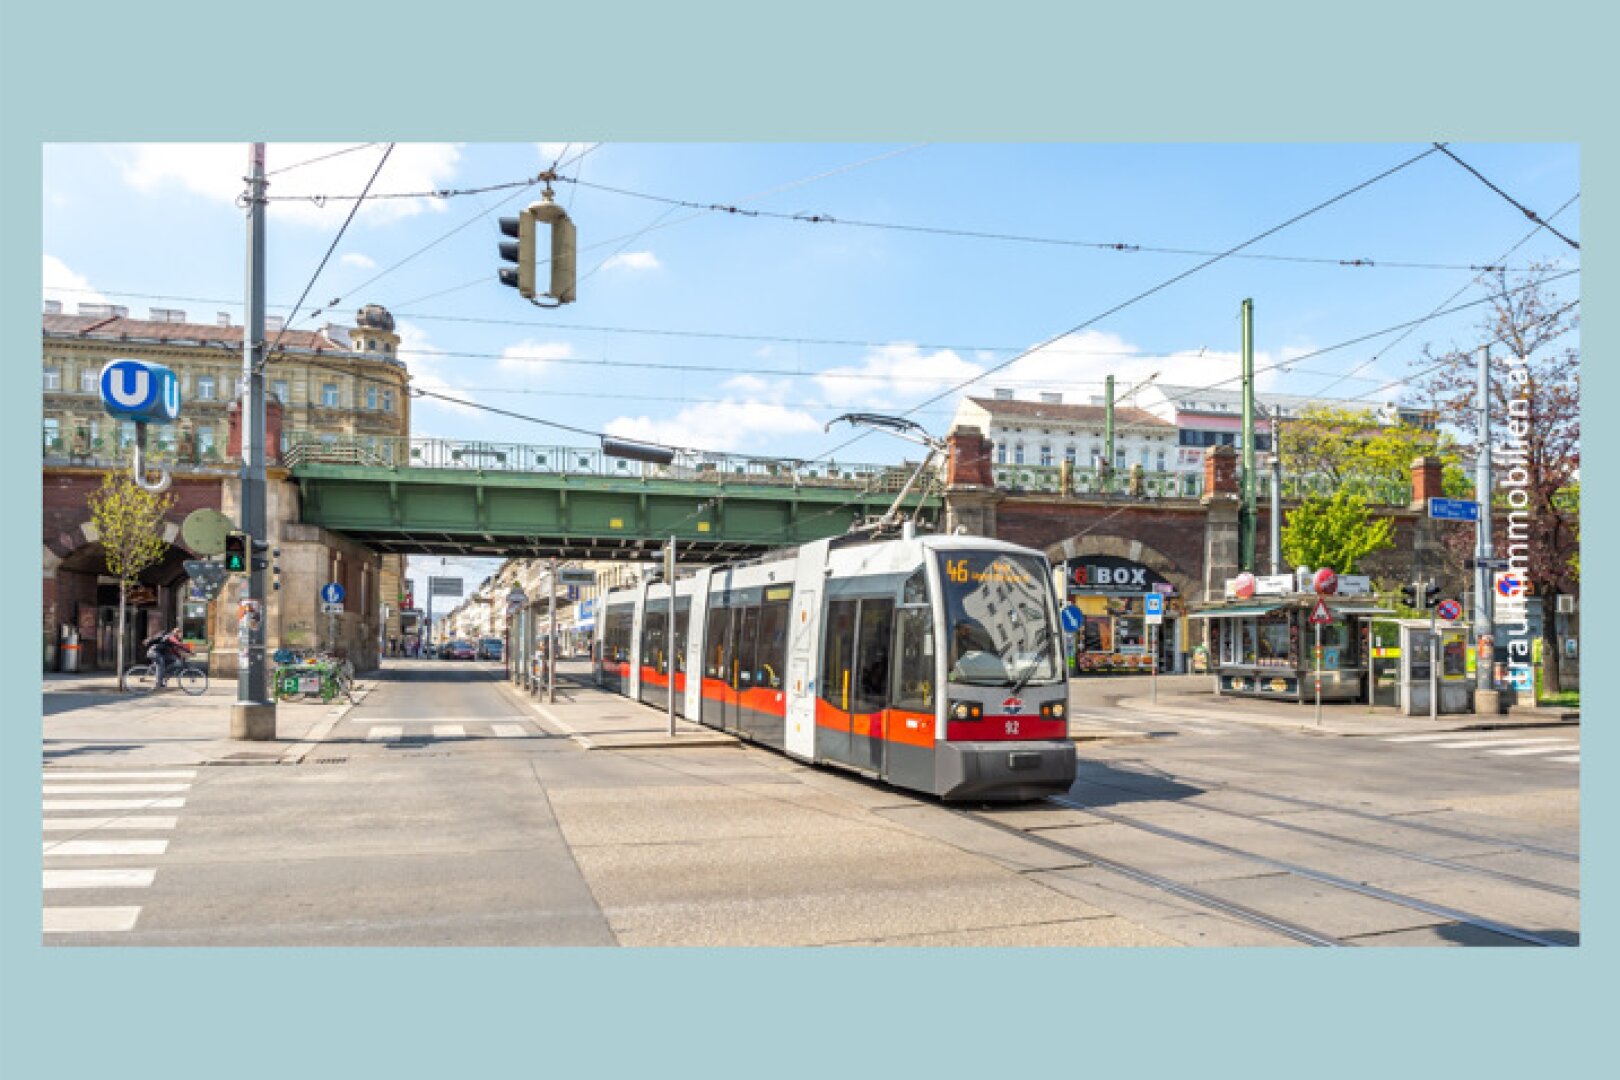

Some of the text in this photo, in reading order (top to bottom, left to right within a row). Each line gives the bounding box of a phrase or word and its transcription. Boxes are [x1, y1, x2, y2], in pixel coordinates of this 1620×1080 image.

[111, 369, 150, 407] U
[946, 559, 969, 582] 46
[1004, 720, 1020, 735] 92
